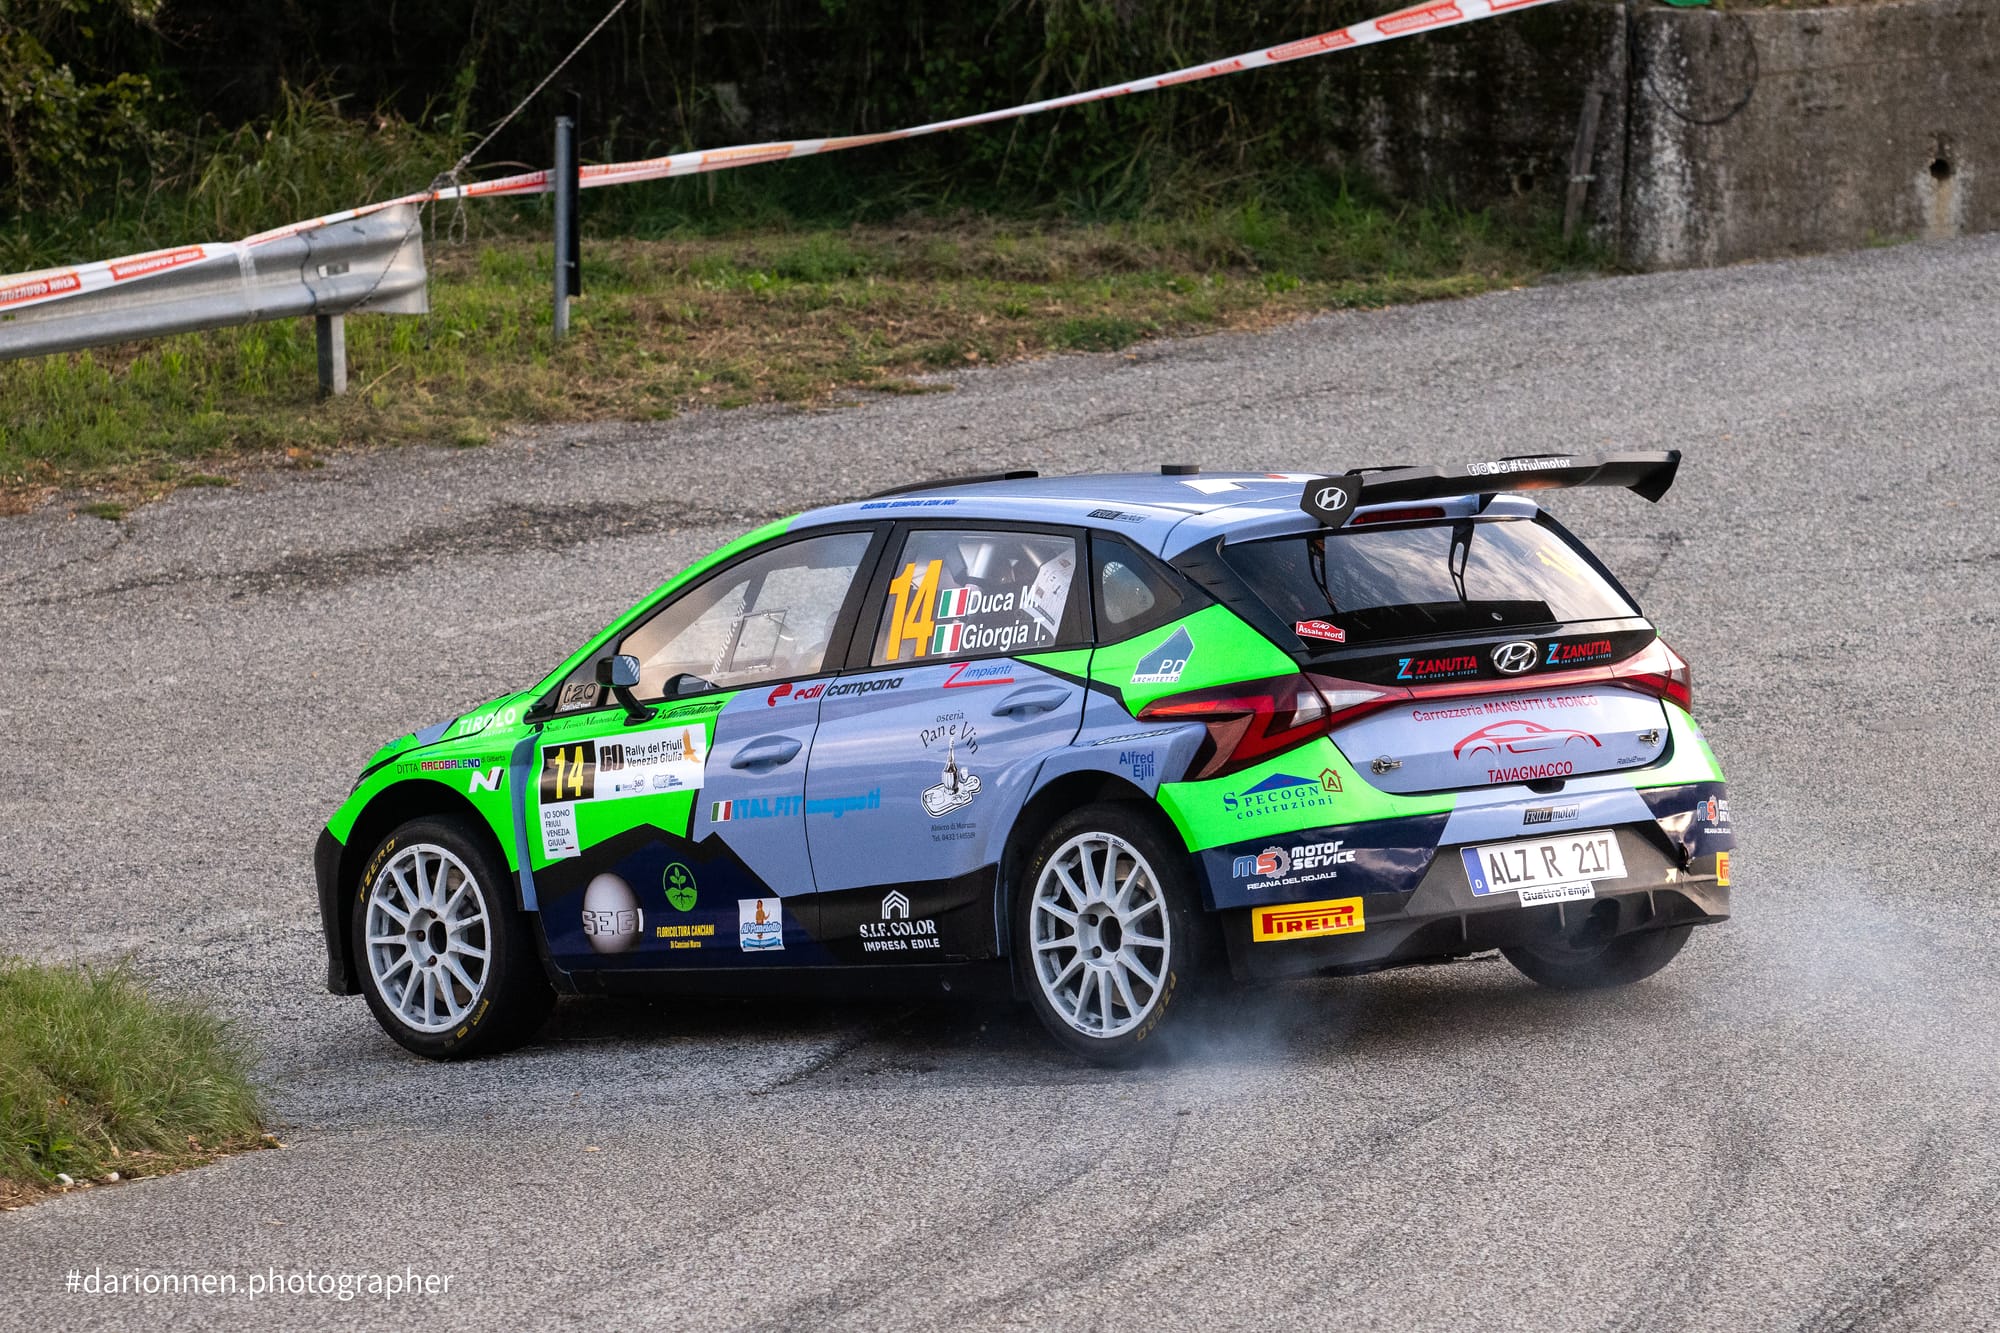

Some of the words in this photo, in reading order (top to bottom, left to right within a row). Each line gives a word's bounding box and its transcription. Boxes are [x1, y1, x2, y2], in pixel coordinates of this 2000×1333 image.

[1509, 458, 1571, 472] #friulmotor
[967, 590, 1015, 615] Duca
[1019, 584, 1039, 610] M.
[887, 559, 943, 661] 14
[961, 619, 1027, 652] Giorgia
[1029, 617, 1046, 642] T.
[1298, 624, 1323, 636] Assale
[1324, 631, 1343, 640] Nord
[1312, 622, 1330, 631] CIAO
[1563, 640, 1612, 659] ZANUTTA
[965, 664, 1014, 680] impianti
[1158, 659, 1186, 675] PD
[1416, 656, 1478, 675] ZANUTTA
[936, 711, 964, 723] osteria
[1412, 704, 1483, 722] Carrozzeria
[1483, 698, 1546, 714] MANSUTTI
[1547, 697, 1556, 709] &
[1557, 695, 1599, 709] RONCO
[459, 707, 517, 738] TIROLO
[920, 724, 945, 749] Pan
[949, 724, 956, 736] e
[960, 721, 979, 755] Vin
[625, 745, 646, 757] Rally
[648, 741, 660, 754] del
[662, 739, 683, 752] Friuli
[626, 755, 658, 768] Venezia
[660, 751, 683, 763] Giulia
[1118, 751, 1154, 765] Alfred
[397, 763, 419, 775] DITTA
[421, 759, 481, 771] ARCOBALENO
[555, 745, 585, 799] 14
[1488, 761, 1573, 784] TAVAGNACCO
[544, 811, 552, 820] IO
[552, 808, 570, 819] SONO
[1237, 796, 1333, 819] costruzioni
[545, 819, 562, 828] FRIULI
[546, 828, 570, 838] VENEZIA
[547, 838, 567, 847] GIULIA
[1475, 879, 1484, 889] D
[1490, 848, 1536, 886] ALZ
[1540, 845, 1564, 879] R
[1572, 839, 1611, 875] 217
[1246, 879, 1282, 891] REANA
[1282, 877, 1301, 886] DEL
[1301, 871, 1337, 882] ROJALE
[1261, 905, 1355, 935] PIRELLI
[656, 924, 691, 939] FLORICOLTURA
[691, 923, 715, 938] CANCIANI
[863, 940, 908, 952] IMPRESA
[911, 938, 940, 949] EDILE
